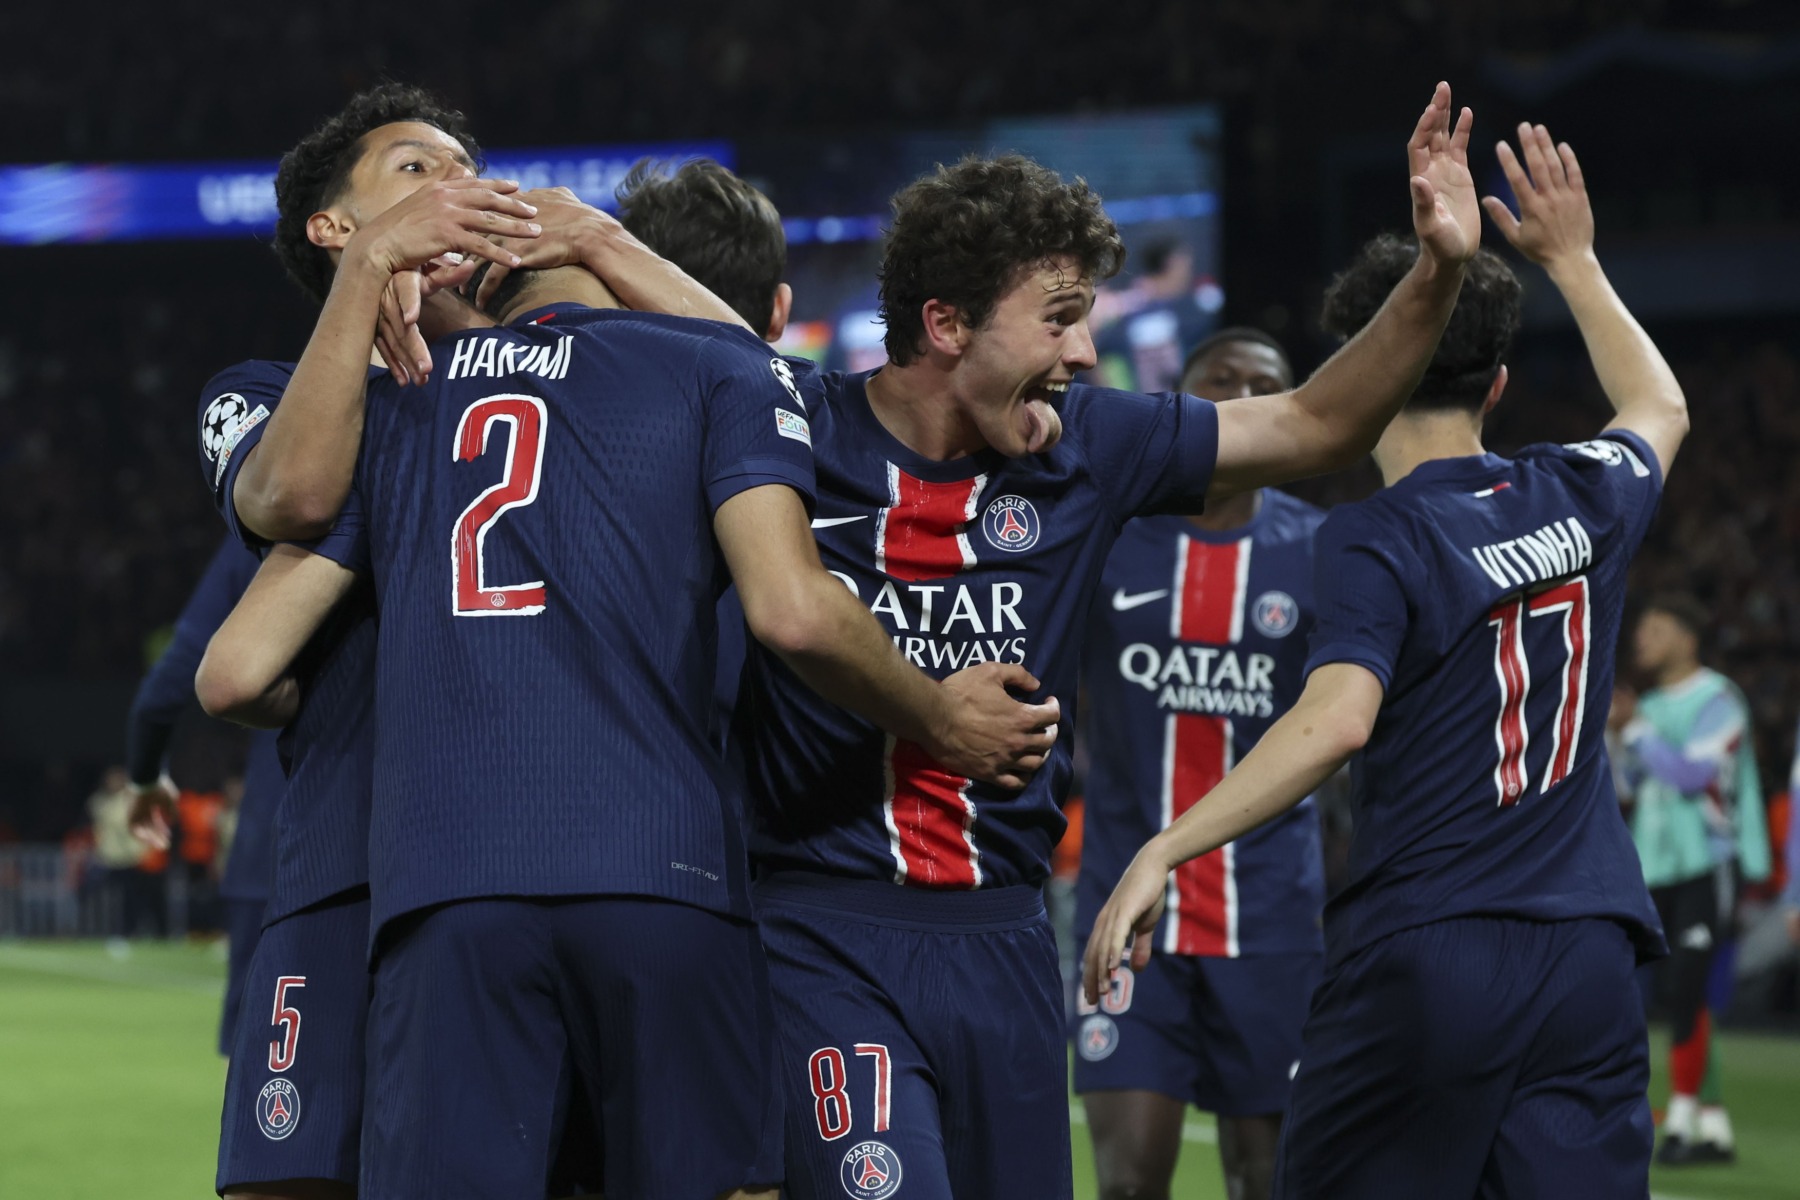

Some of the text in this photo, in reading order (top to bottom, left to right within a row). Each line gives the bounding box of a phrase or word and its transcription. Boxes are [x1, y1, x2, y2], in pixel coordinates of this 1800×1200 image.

[447, 335, 574, 380] HAKIMI
[451, 393, 548, 616] 2
[989, 497, 1027, 515] PARIS
[1472, 517, 1592, 589] VITINHA
[828, 570, 1027, 635] ATAR
[893, 636, 1026, 670] RWAYS
[1118, 642, 1276, 692] QATAR
[1157, 683, 1274, 718] AIRWAYS
[1488, 575, 1591, 807] 17
[268, 976, 307, 1072] 5
[262, 1081, 292, 1098] PARIS
[808, 1042, 892, 1141] 87
[846, 1144, 886, 1164] PARIS
